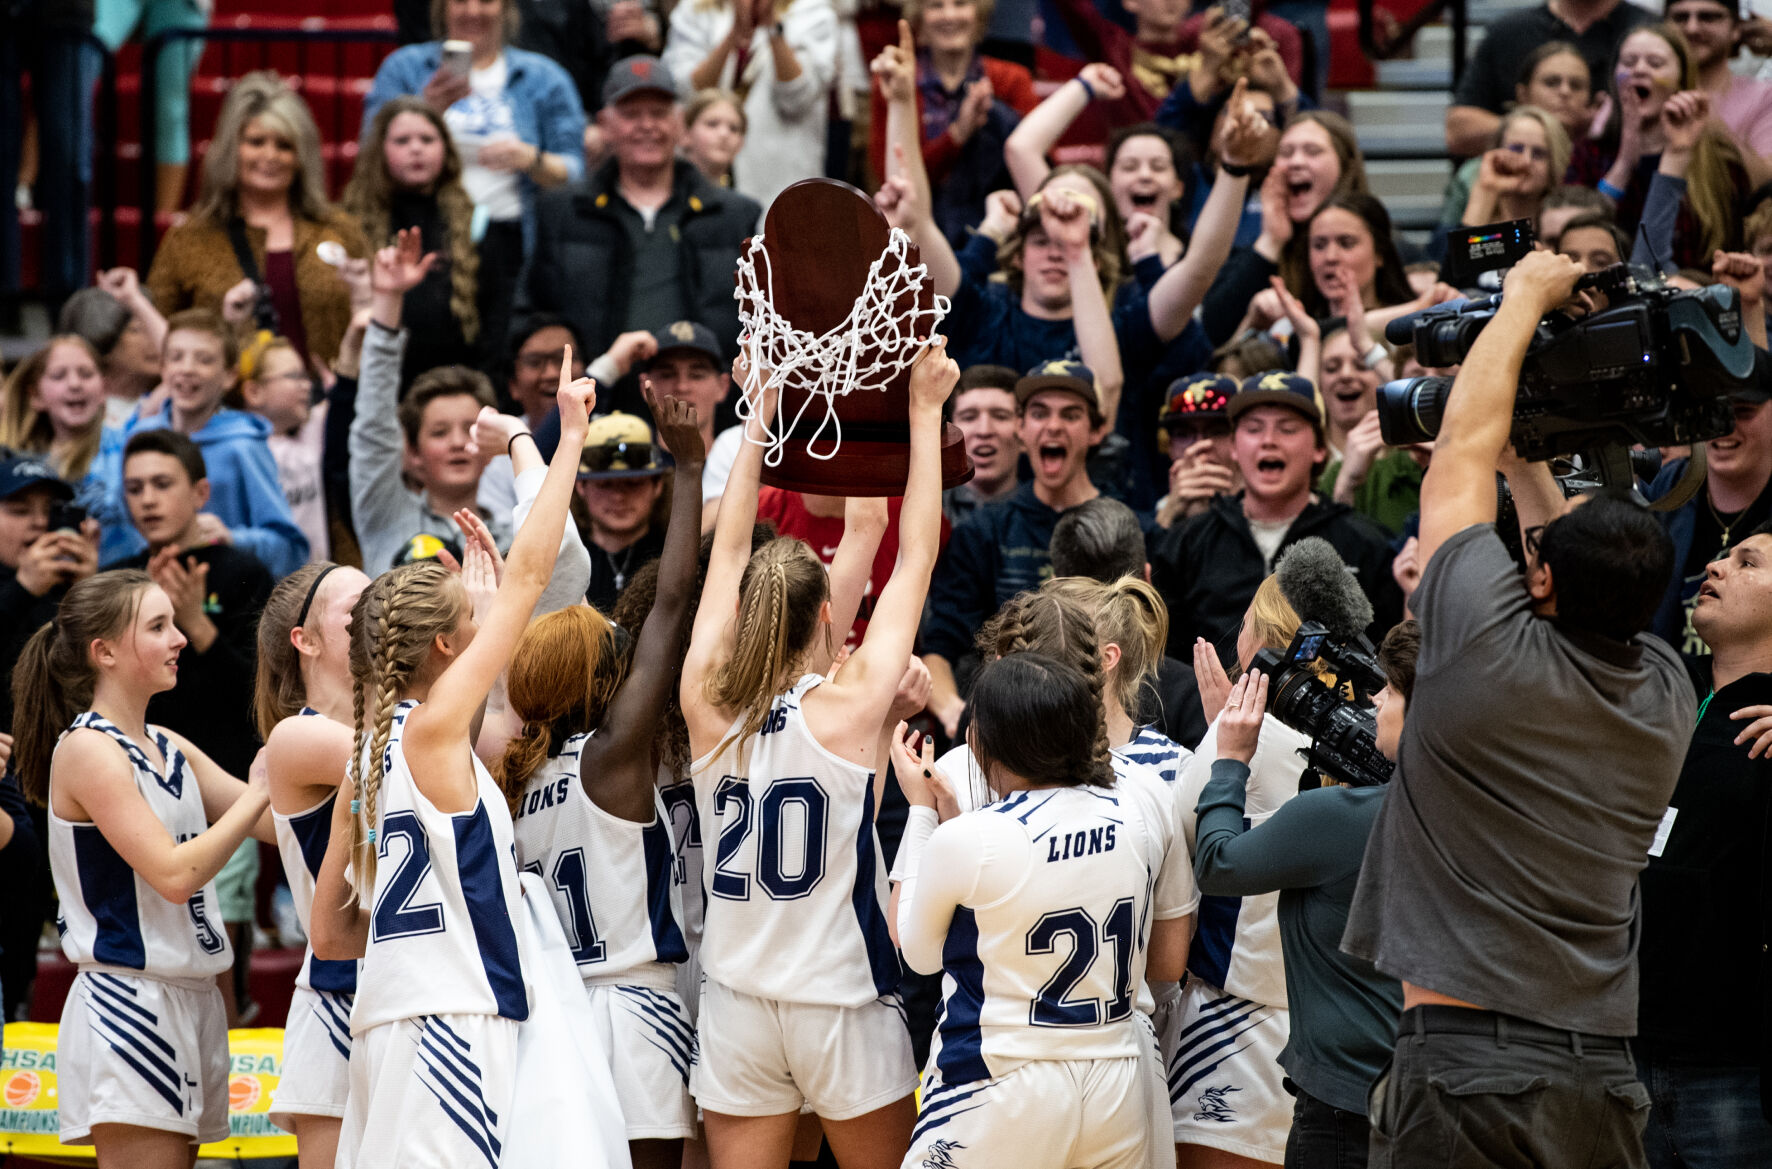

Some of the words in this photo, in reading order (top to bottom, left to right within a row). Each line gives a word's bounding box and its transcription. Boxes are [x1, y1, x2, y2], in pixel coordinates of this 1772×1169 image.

[518, 777, 569, 819] IONS
[712, 775, 829, 901] 20
[1047, 824, 1117, 863] LIONS
[372, 810, 446, 944] 2
[1025, 896, 1135, 1027] 21
